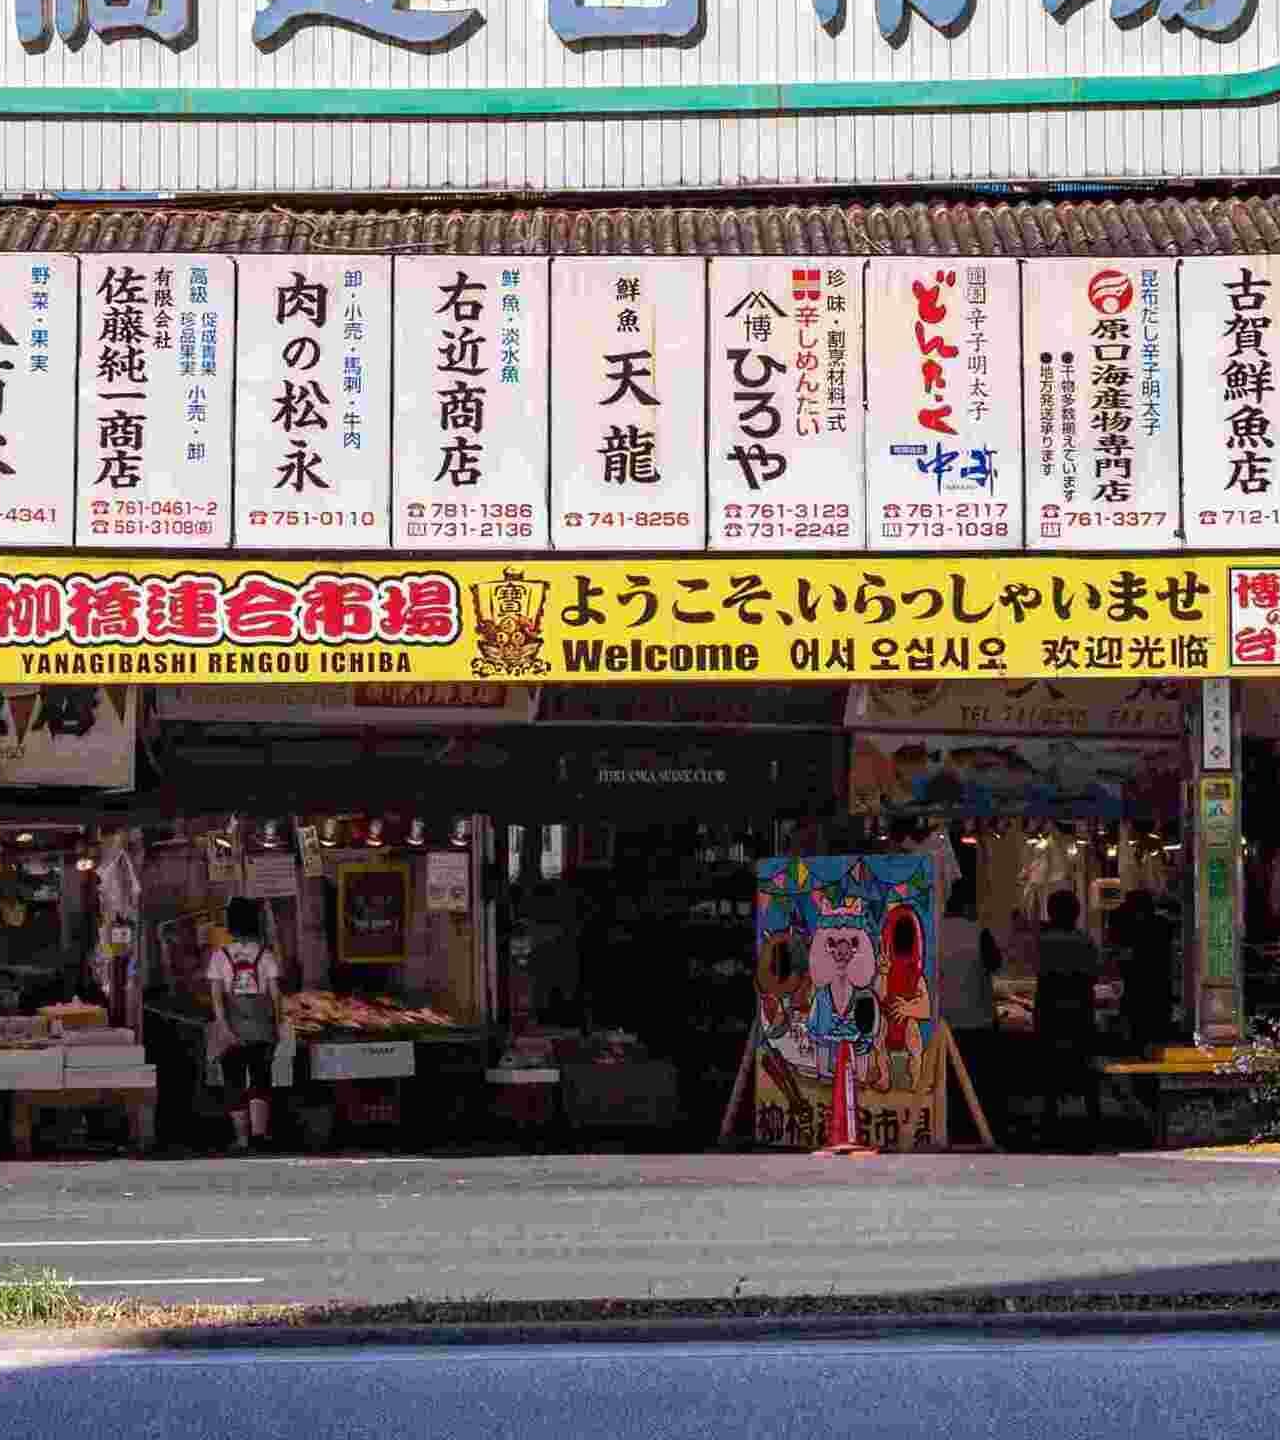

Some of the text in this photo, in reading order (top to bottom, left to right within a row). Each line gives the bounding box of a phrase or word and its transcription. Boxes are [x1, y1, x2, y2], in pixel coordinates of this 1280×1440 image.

[188, 268, 208, 304] 高級
[30, 264, 50, 372] 野菜・果実
[152, 266, 174, 350] 有限会社
[615, 277, 641, 333] 鮮魚
[93, 265, 151, 490] 佐藤純一商店
[271, 271, 331, 493] 肉の松永
[434, 271, 489, 488] 右近商店
[794, 308, 820, 437] 辛しめんたい
[1221, 268, 1276, 495] 古賀鮮魚店
[598, 350, 662, 486] 天龍
[725, 347, 788, 490] ひろや
[1088, 318, 1135, 503] 原口海産物専門店
[273, 512, 374, 527] 751-0110
[432, 504, 533, 519] 781-1386
[588, 512, 690, 527] 741-8256
[747, 504, 850, 518] 761-3123
[906, 503, 1008, 518] 761-2117
[1066, 511, 1167, 526] 761-3377
[432, 523, 533, 537] 731-2136
[747, 522, 850, 537] 731-2242
[906, 522, 1008, 537] 713-1038
[21, 652, 412, 674] YANAGIBASHI RENGOU ICHIBA
[564, 639, 760, 672] Welcome
[790, 637, 1008, 672] 어서 오십시오
[1041, 636, 1209, 670] 欢迎光临
